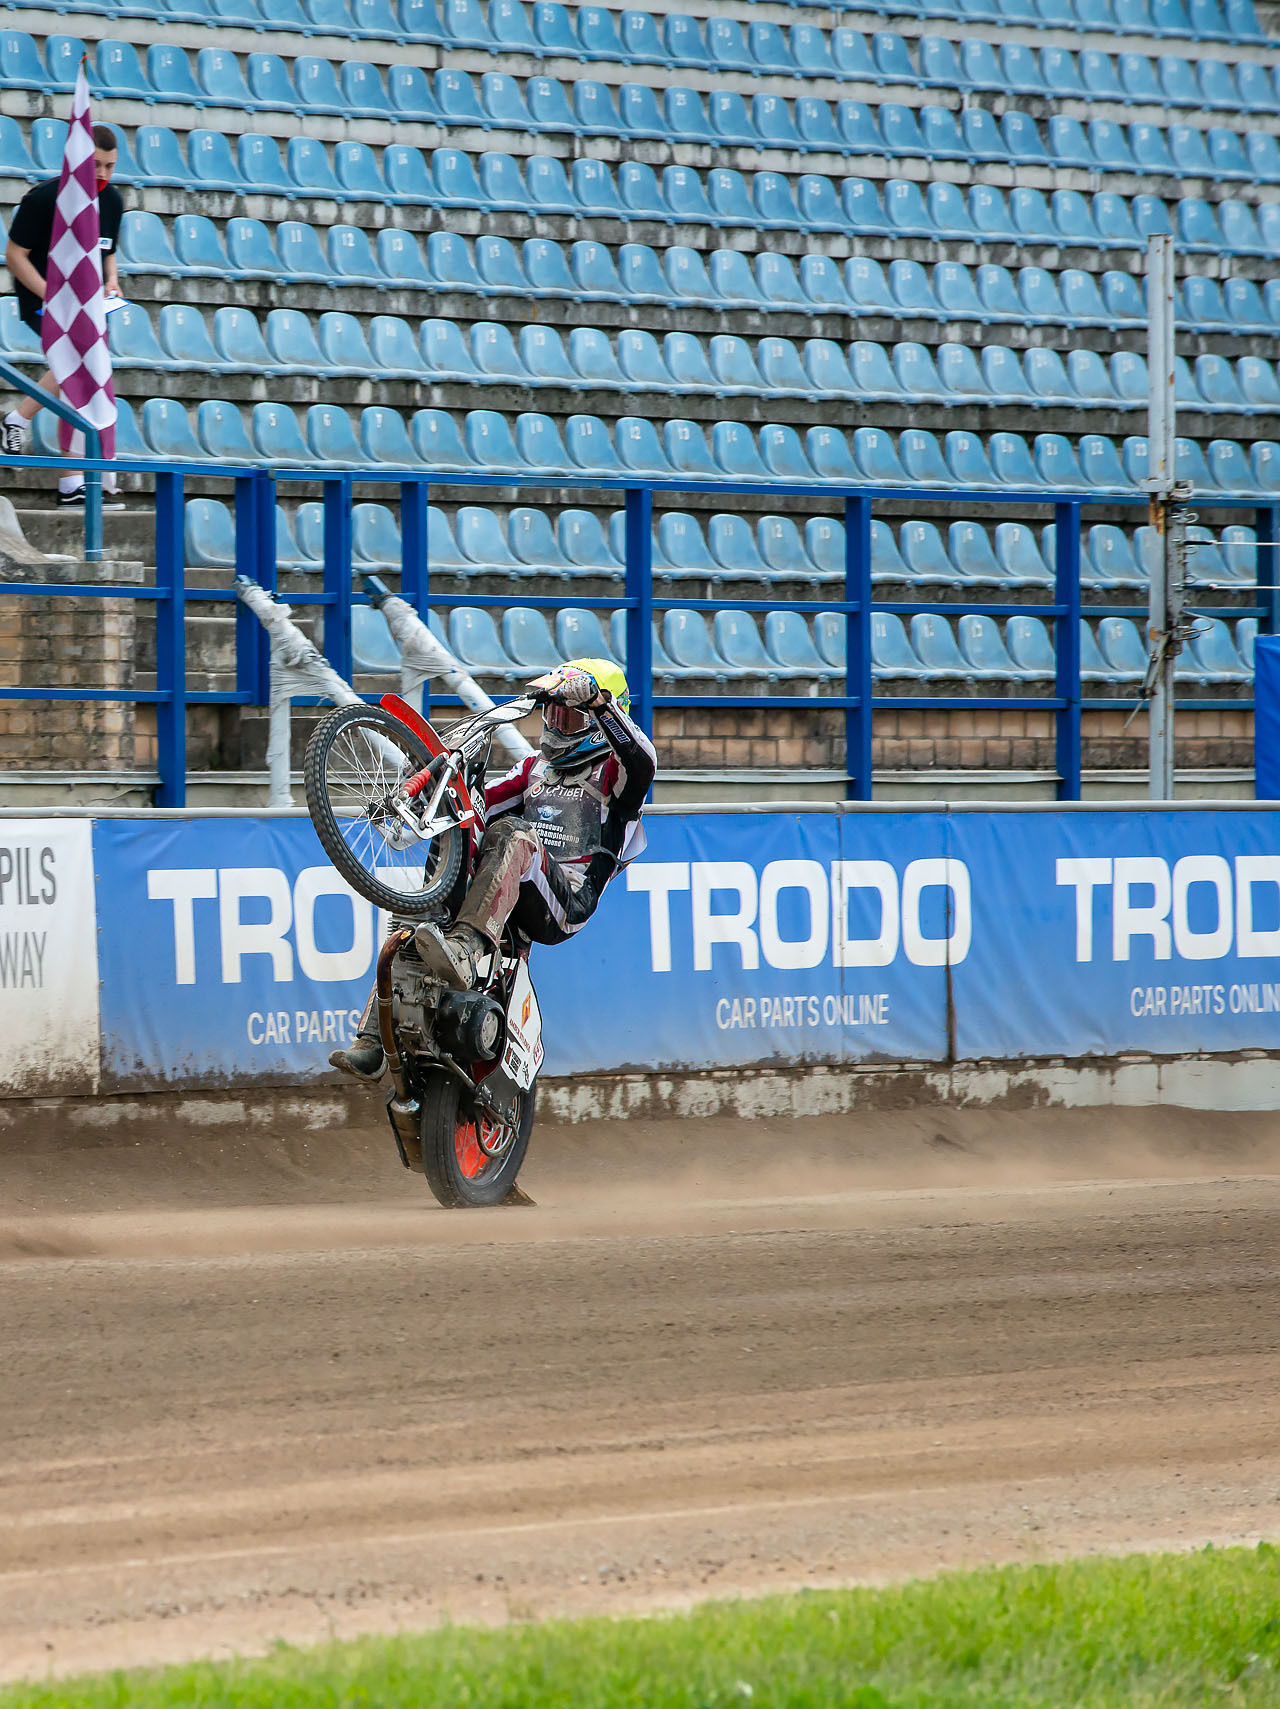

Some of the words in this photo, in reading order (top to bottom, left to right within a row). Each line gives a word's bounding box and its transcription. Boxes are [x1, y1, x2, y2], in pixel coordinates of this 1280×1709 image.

[626, 859, 972, 972] TRODO
[716, 998, 756, 1030] CAR
[761, 995, 820, 1028] PARTS
[823, 993, 890, 1025] ONLINE
[1130, 986, 1167, 1017] CAR
[1171, 984, 1225, 1015] PARTS
[247, 1012, 290, 1044] CAR
[295, 1009, 360, 1043] PARTS
